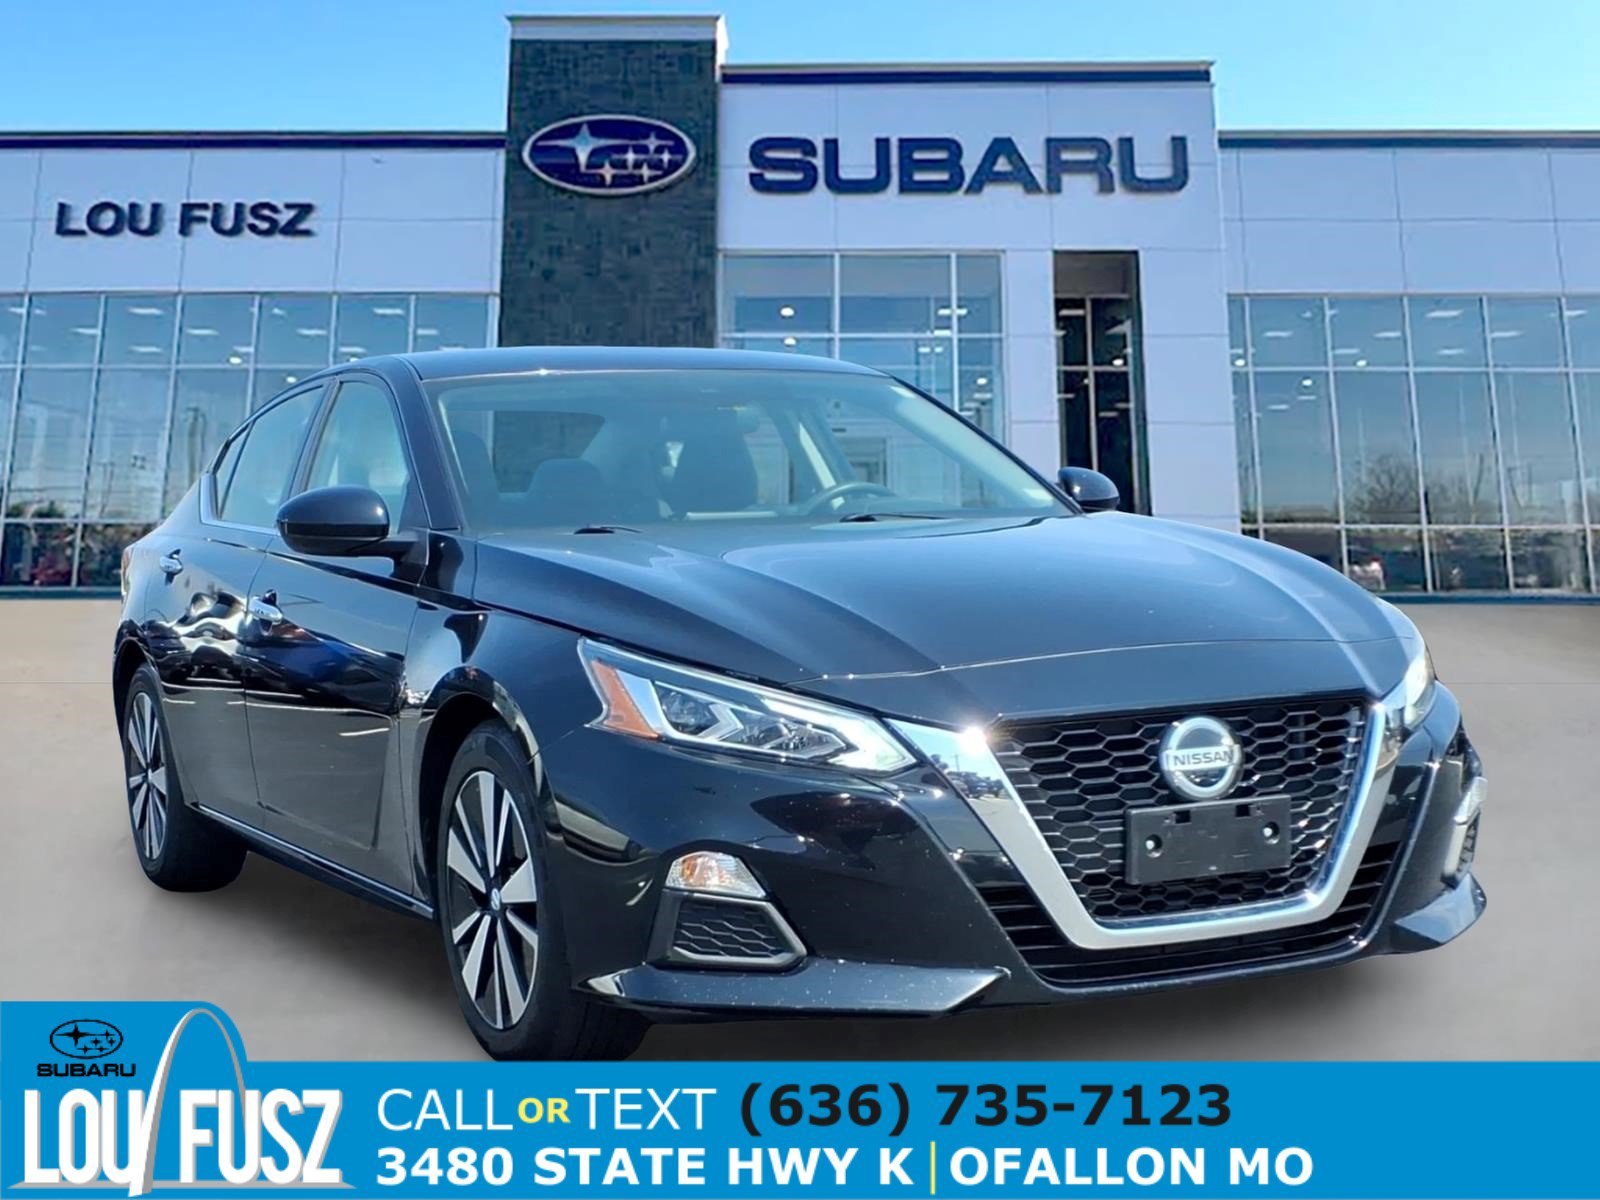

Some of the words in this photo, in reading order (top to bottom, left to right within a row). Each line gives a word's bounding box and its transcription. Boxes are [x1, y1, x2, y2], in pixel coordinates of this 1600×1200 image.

[748, 135, 1190, 195] SUBARU
[55, 201, 164, 239] LOU
[178, 201, 316, 239] FUSZ
[1172, 749, 1234, 767] NISSAN
